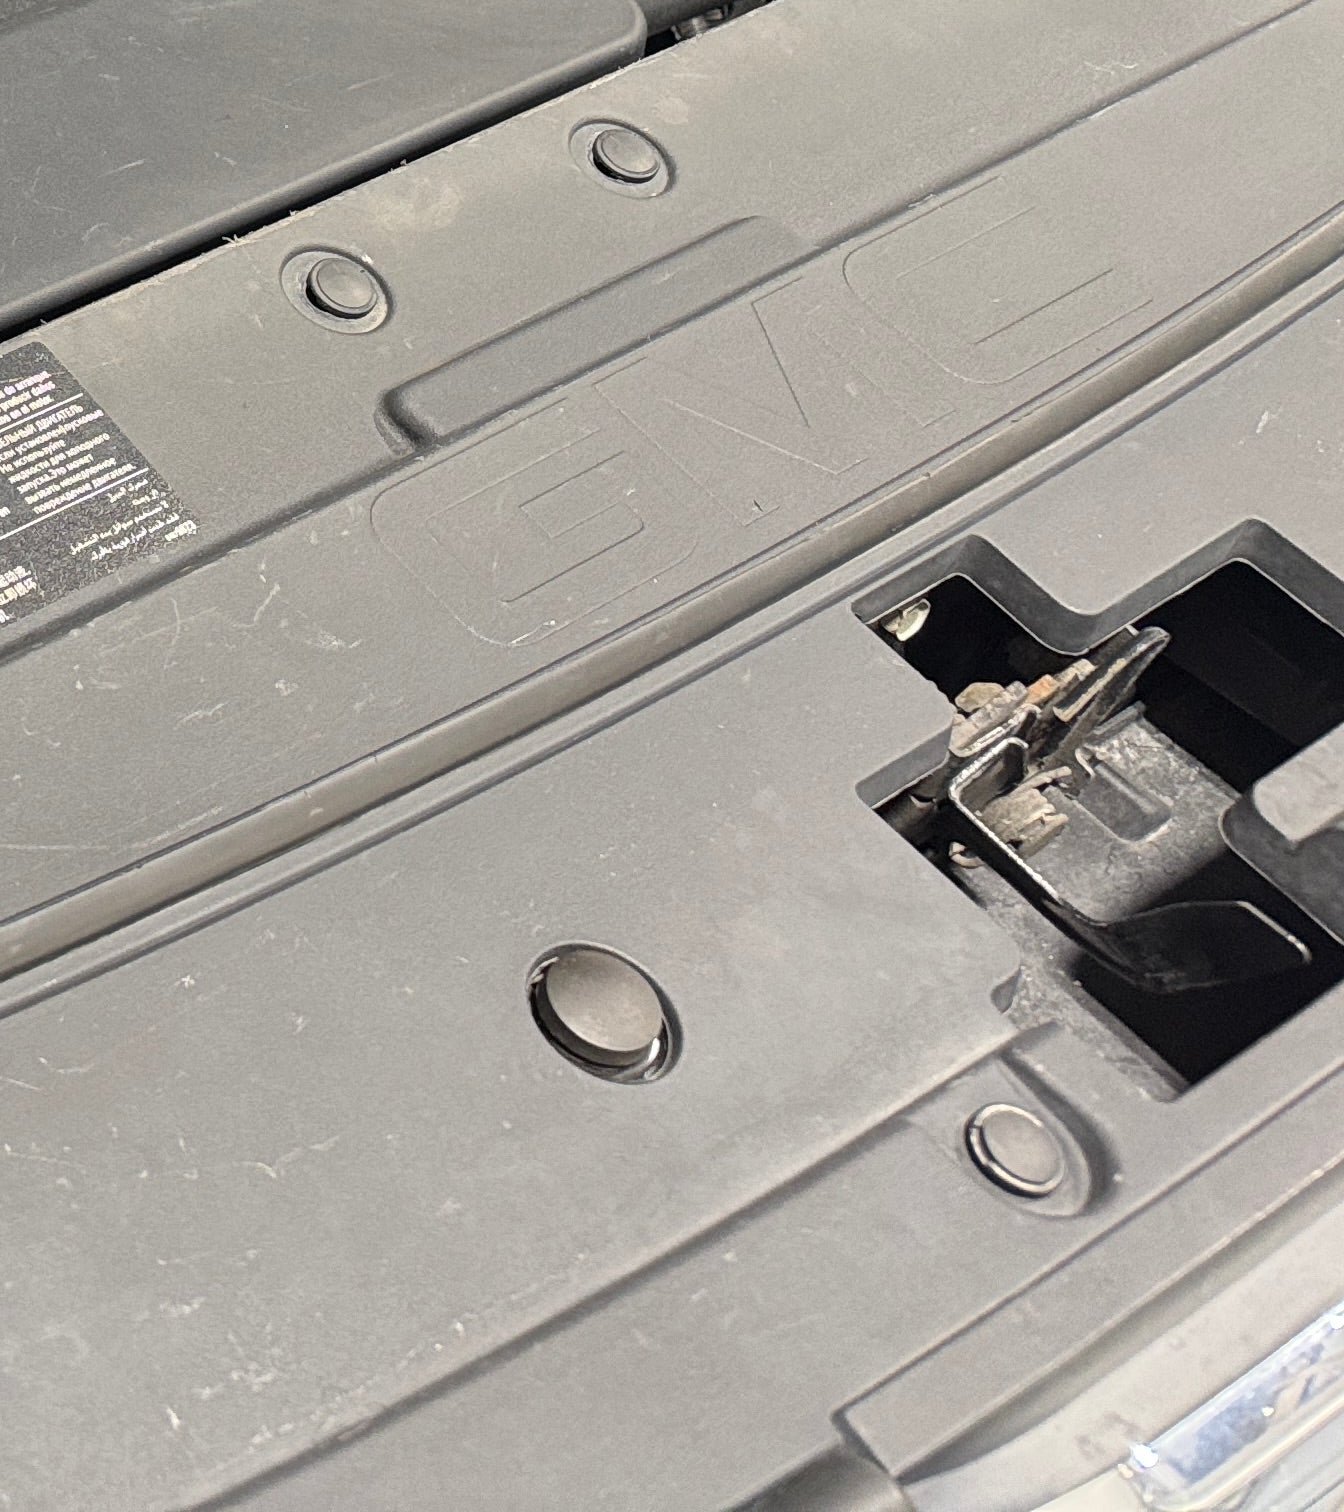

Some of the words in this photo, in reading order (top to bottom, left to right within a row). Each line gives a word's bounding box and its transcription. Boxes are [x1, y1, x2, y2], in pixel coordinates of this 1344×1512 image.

[34, 403, 84, 432] ДВИГАТЕЛЬ
[370, 175, 1152, 646] GMC
[7, 459, 51, 484] жидкости
[64, 432, 110, 458] холодного
